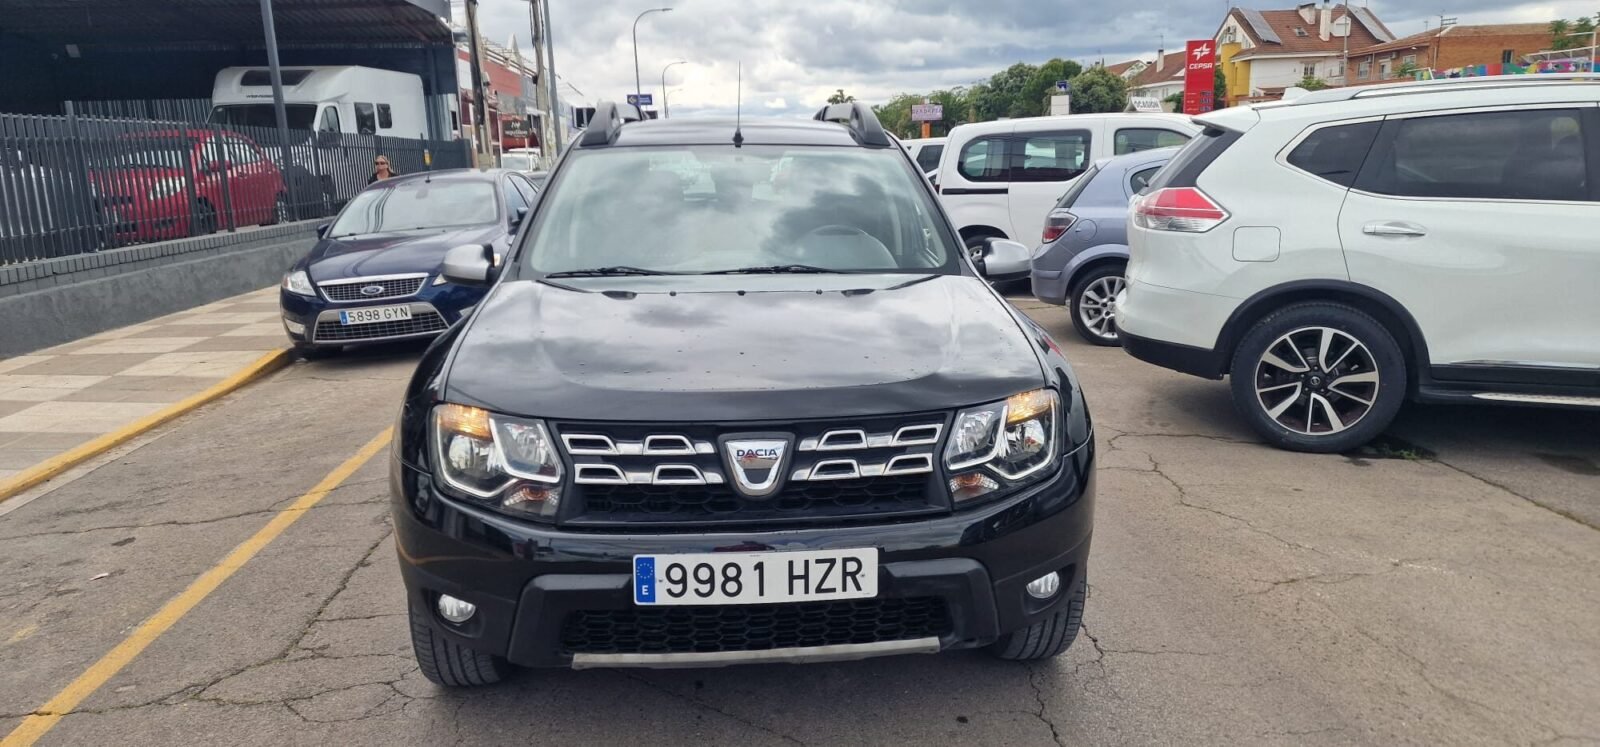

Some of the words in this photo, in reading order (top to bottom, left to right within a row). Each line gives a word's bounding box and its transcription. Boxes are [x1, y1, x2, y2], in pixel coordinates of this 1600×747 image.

[1189, 62, 1213, 70] CEPSA
[348, 309, 380, 322] 5898
[384, 307, 408, 320] GYN
[736, 448, 778, 457] DACIA
[665, 561, 764, 598] 9981
[788, 556, 864, 596] HZR
[642, 585, 649, 595] E
